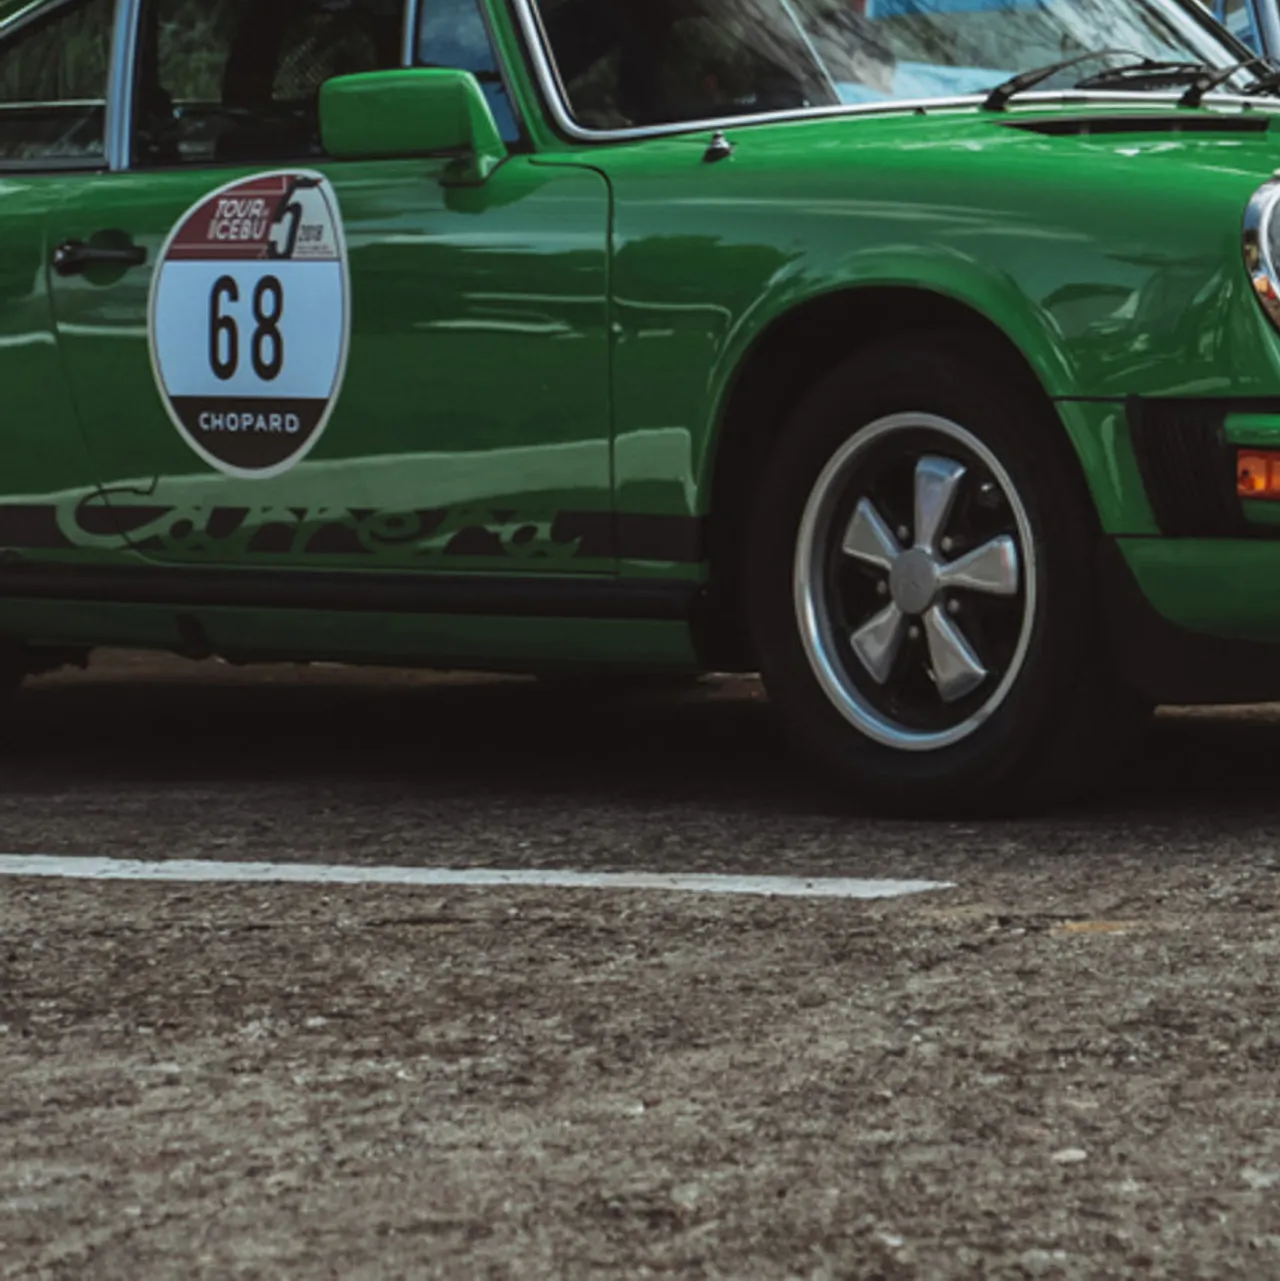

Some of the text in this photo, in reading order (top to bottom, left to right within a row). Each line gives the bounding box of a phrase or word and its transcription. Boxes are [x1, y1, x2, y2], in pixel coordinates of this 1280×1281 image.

[216, 199, 264, 217] TOUR
[209, 274, 283, 382] 68
[199, 412, 300, 433] CHOPARD
[56, 488, 584, 558] Carrera
